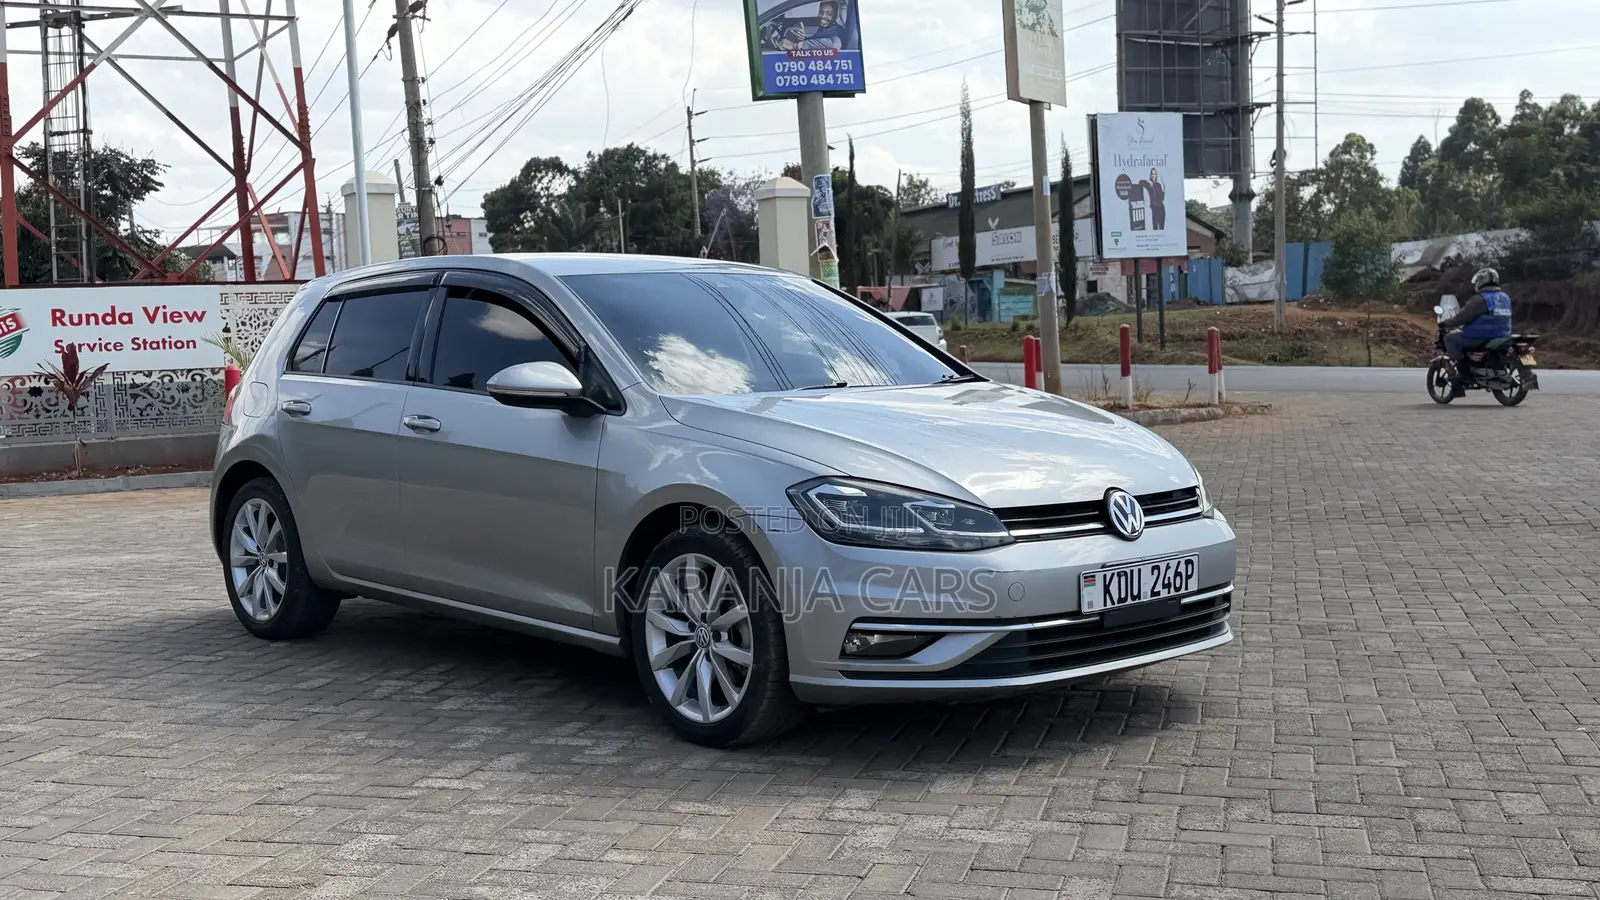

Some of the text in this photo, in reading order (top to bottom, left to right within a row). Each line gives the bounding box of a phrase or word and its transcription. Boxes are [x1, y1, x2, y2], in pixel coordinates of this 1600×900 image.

[775, 60, 853, 73] 0790 484 751
[776, 73, 855, 87] 0780 484 751
[51, 304, 207, 327] Runda View
[131, 335, 197, 351] Station
[1103, 558, 1195, 607] KDU 246P
